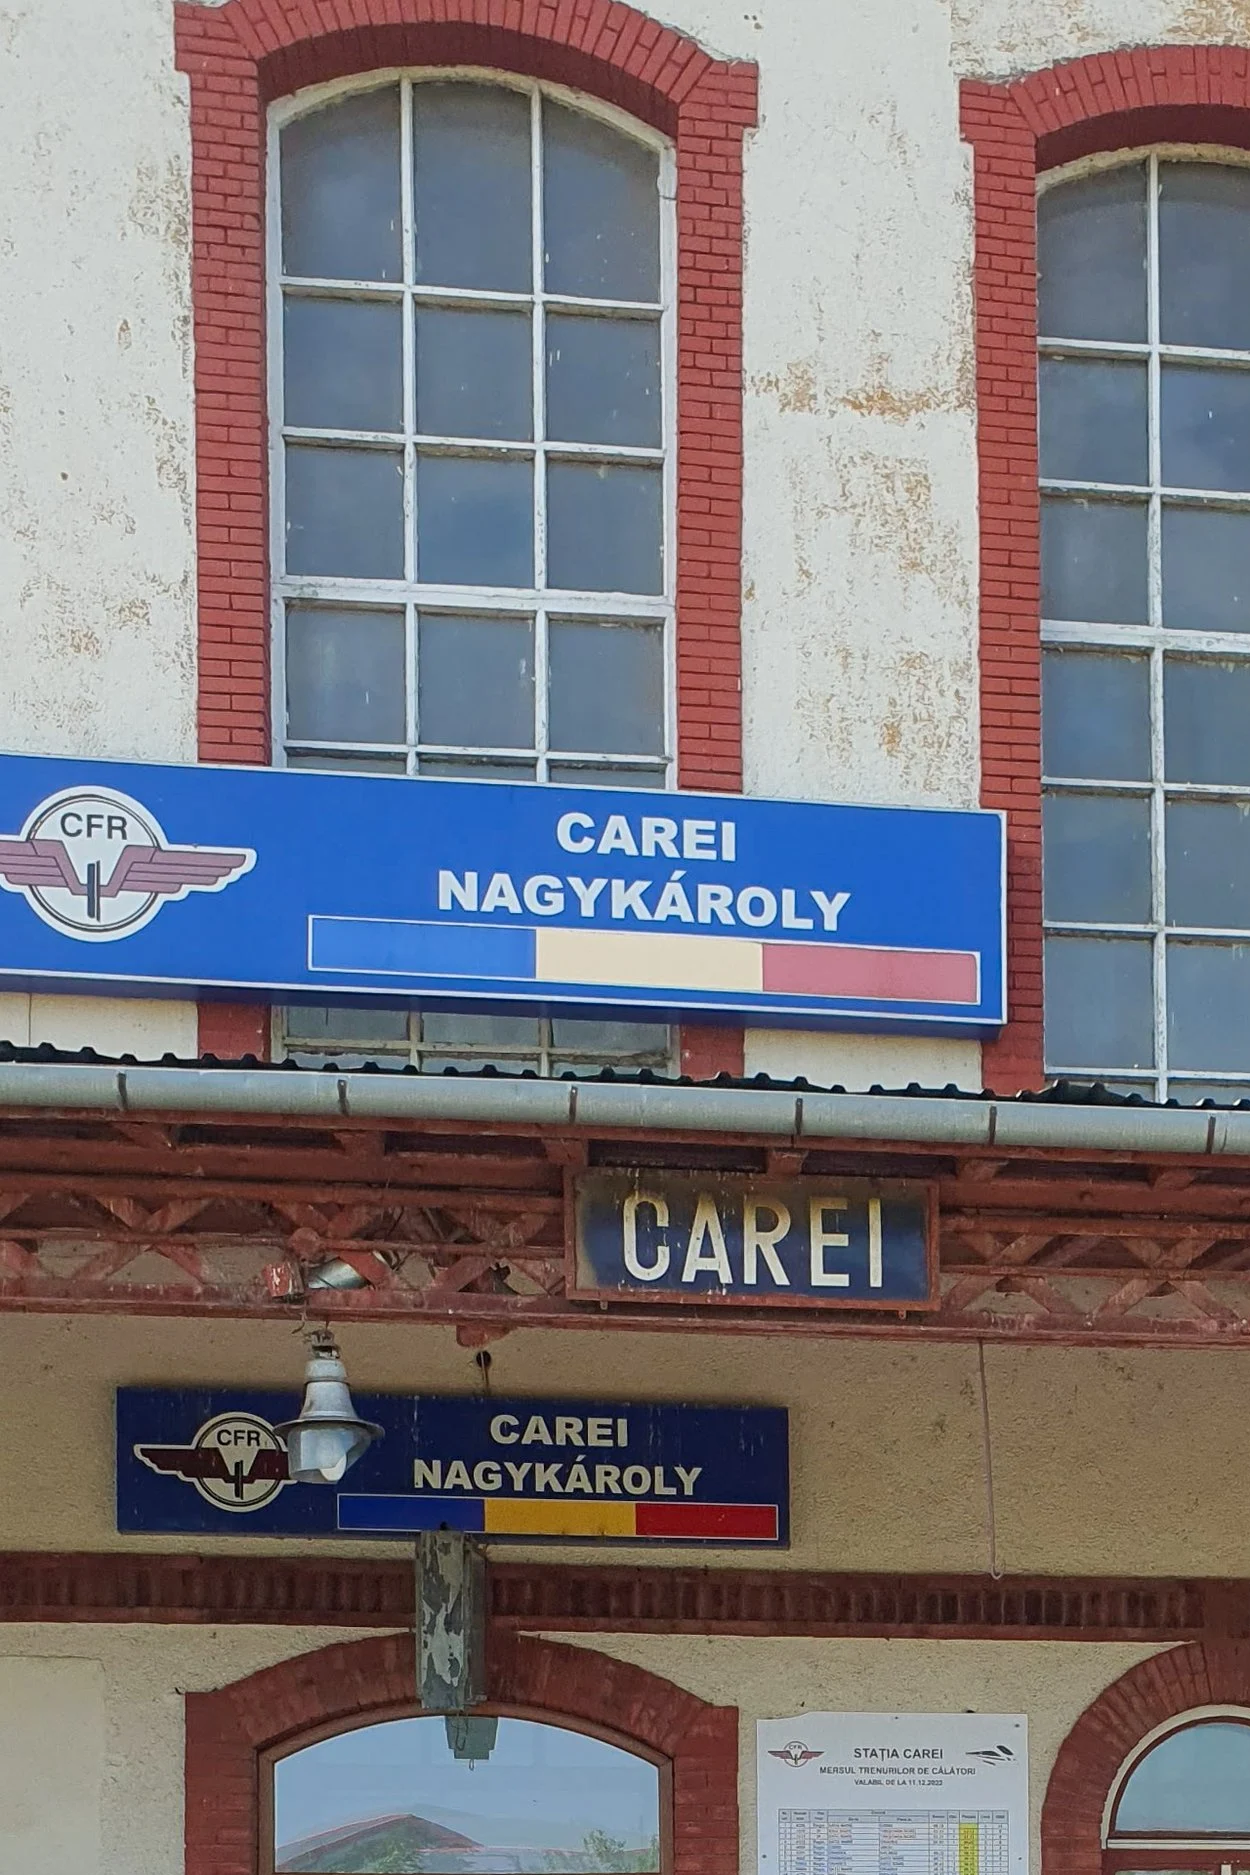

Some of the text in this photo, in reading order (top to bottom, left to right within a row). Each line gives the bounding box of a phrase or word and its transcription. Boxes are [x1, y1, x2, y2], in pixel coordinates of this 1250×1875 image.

[60, 811, 128, 841] CFR
[556, 811, 737, 862] CAREI
[437, 869, 852, 932] NAGYKÁROLY
[622, 1194, 883, 1288] CAREI
[216, 1429, 261, 1447] CFR
[489, 1413, 629, 1448] CAREI
[413, 1454, 703, 1496] NAGYKÁROLY
[902, 1748, 944, 1760] CAREI
[819, 1766, 857, 1775] MERSUL
[858, 1766, 916, 1776] TRENURILOR
[917, 1766, 930, 1776] DE
[885, 1779, 897, 1787] DE
[897, 1779, 908, 1787] LA
